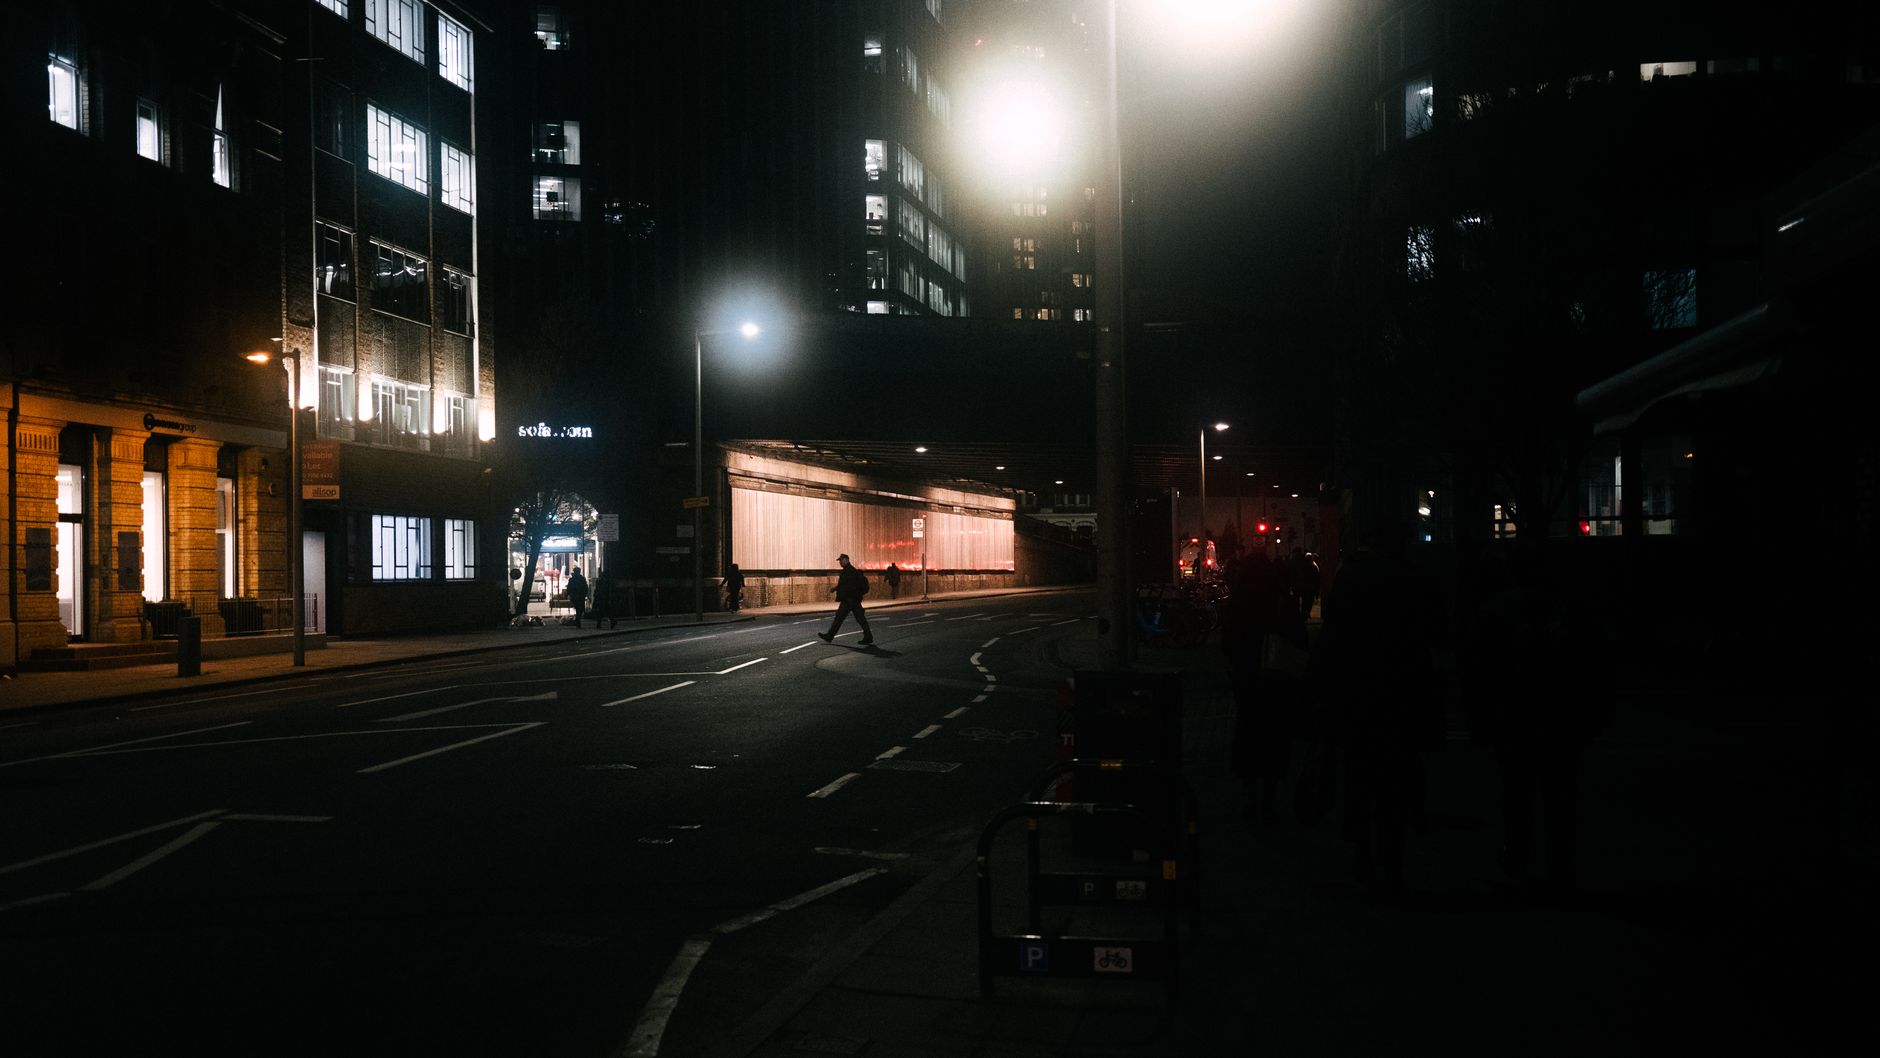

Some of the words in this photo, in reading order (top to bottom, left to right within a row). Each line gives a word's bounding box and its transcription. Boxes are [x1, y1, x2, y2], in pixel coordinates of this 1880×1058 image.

[303, 451, 334, 459] vailable
[312, 487, 337, 497] allsop
[1083, 881, 1095, 897] P
[1026, 946, 1044, 969] P
